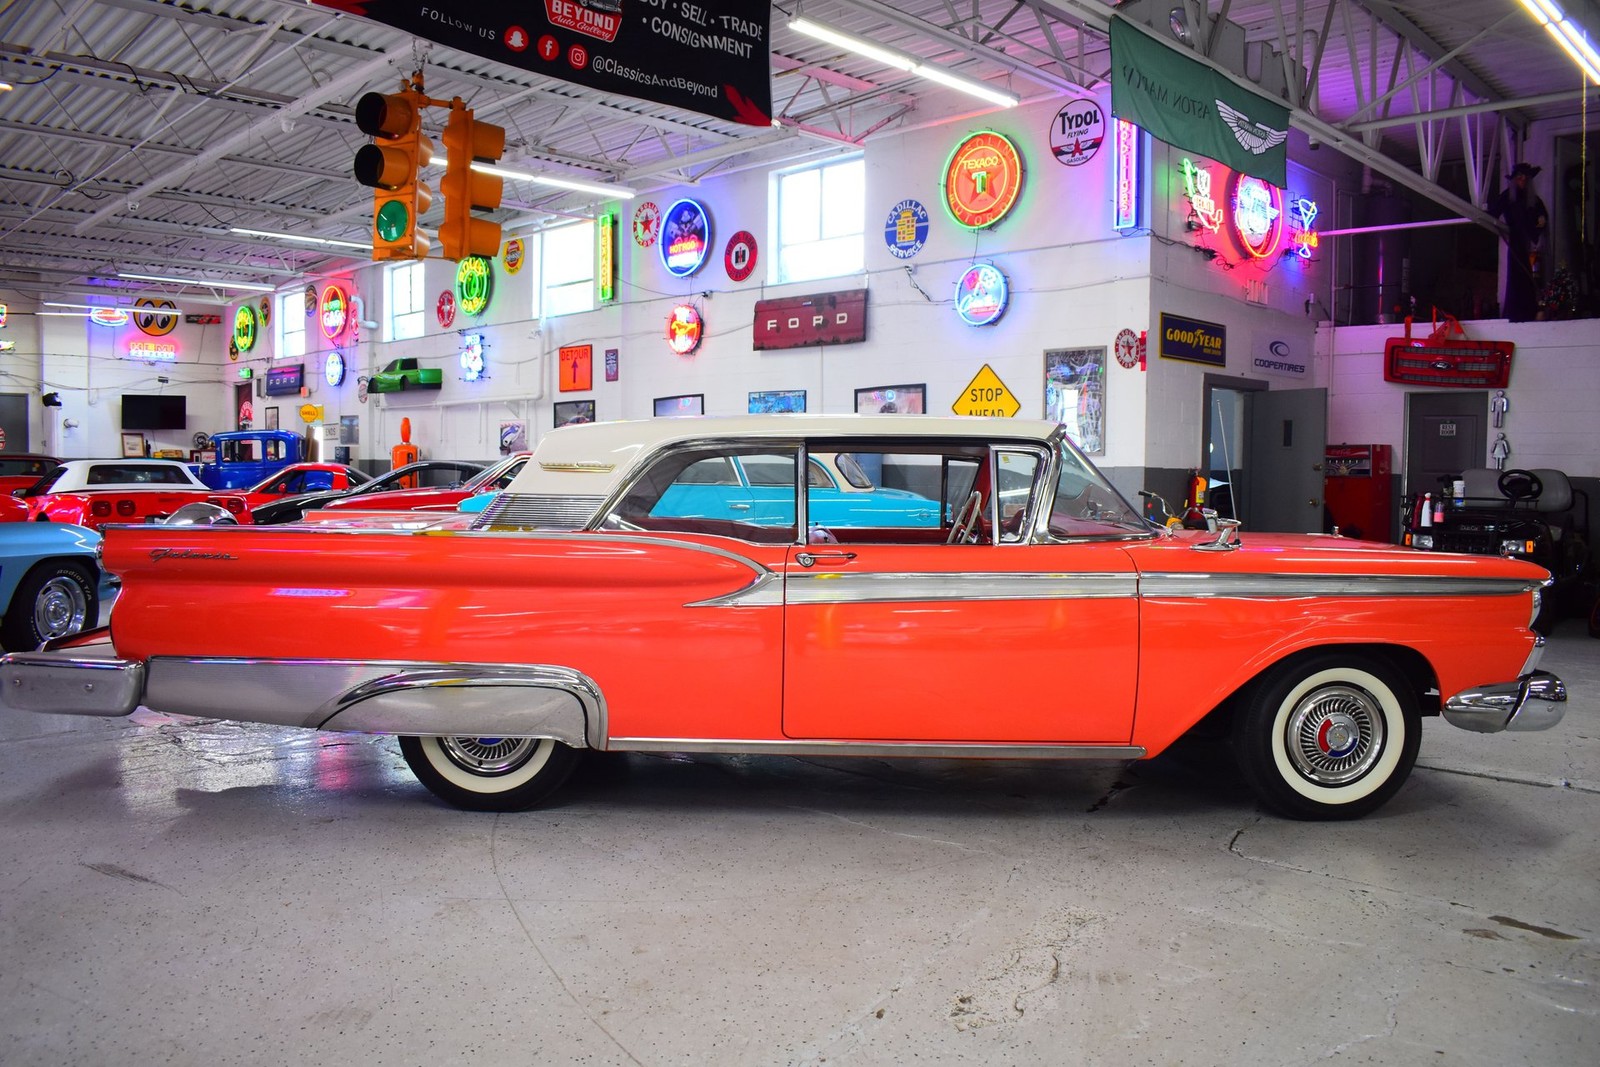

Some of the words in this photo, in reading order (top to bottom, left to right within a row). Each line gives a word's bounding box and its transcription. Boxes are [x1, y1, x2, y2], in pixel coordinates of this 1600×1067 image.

[421, 7, 473, 33] FOLLOW
[478, 27, 497, 41] US
[552, 0, 614, 31] BEYOND
[553, 15, 576, 27] Auto
[577, 22, 611, 40] Gallery
[680, 2, 707, 27] SELL
[719, 15, 763, 42] TRADE
[651, 17, 753, 59] CONSIGNMENT
[592, 55, 718, 99] @ClassicsAndBeyond
[1059, 109, 1100, 135] TYDOL
[1067, 128, 1089, 139] FLYING
[962, 155, 999, 170] TEXACO
[887, 199, 928, 225] CADILLAC
[888, 239, 923, 259] SERVICE
[767, 312, 848, 331] FORD
[130, 341, 175, 353] HEMI
[561, 348, 589, 361] DETOUR
[269, 376, 296, 386] FORD
[970, 387, 1004, 403] STOP
[56, 569, 84, 583] Radial
[84, 585, 93, 601] T/A
